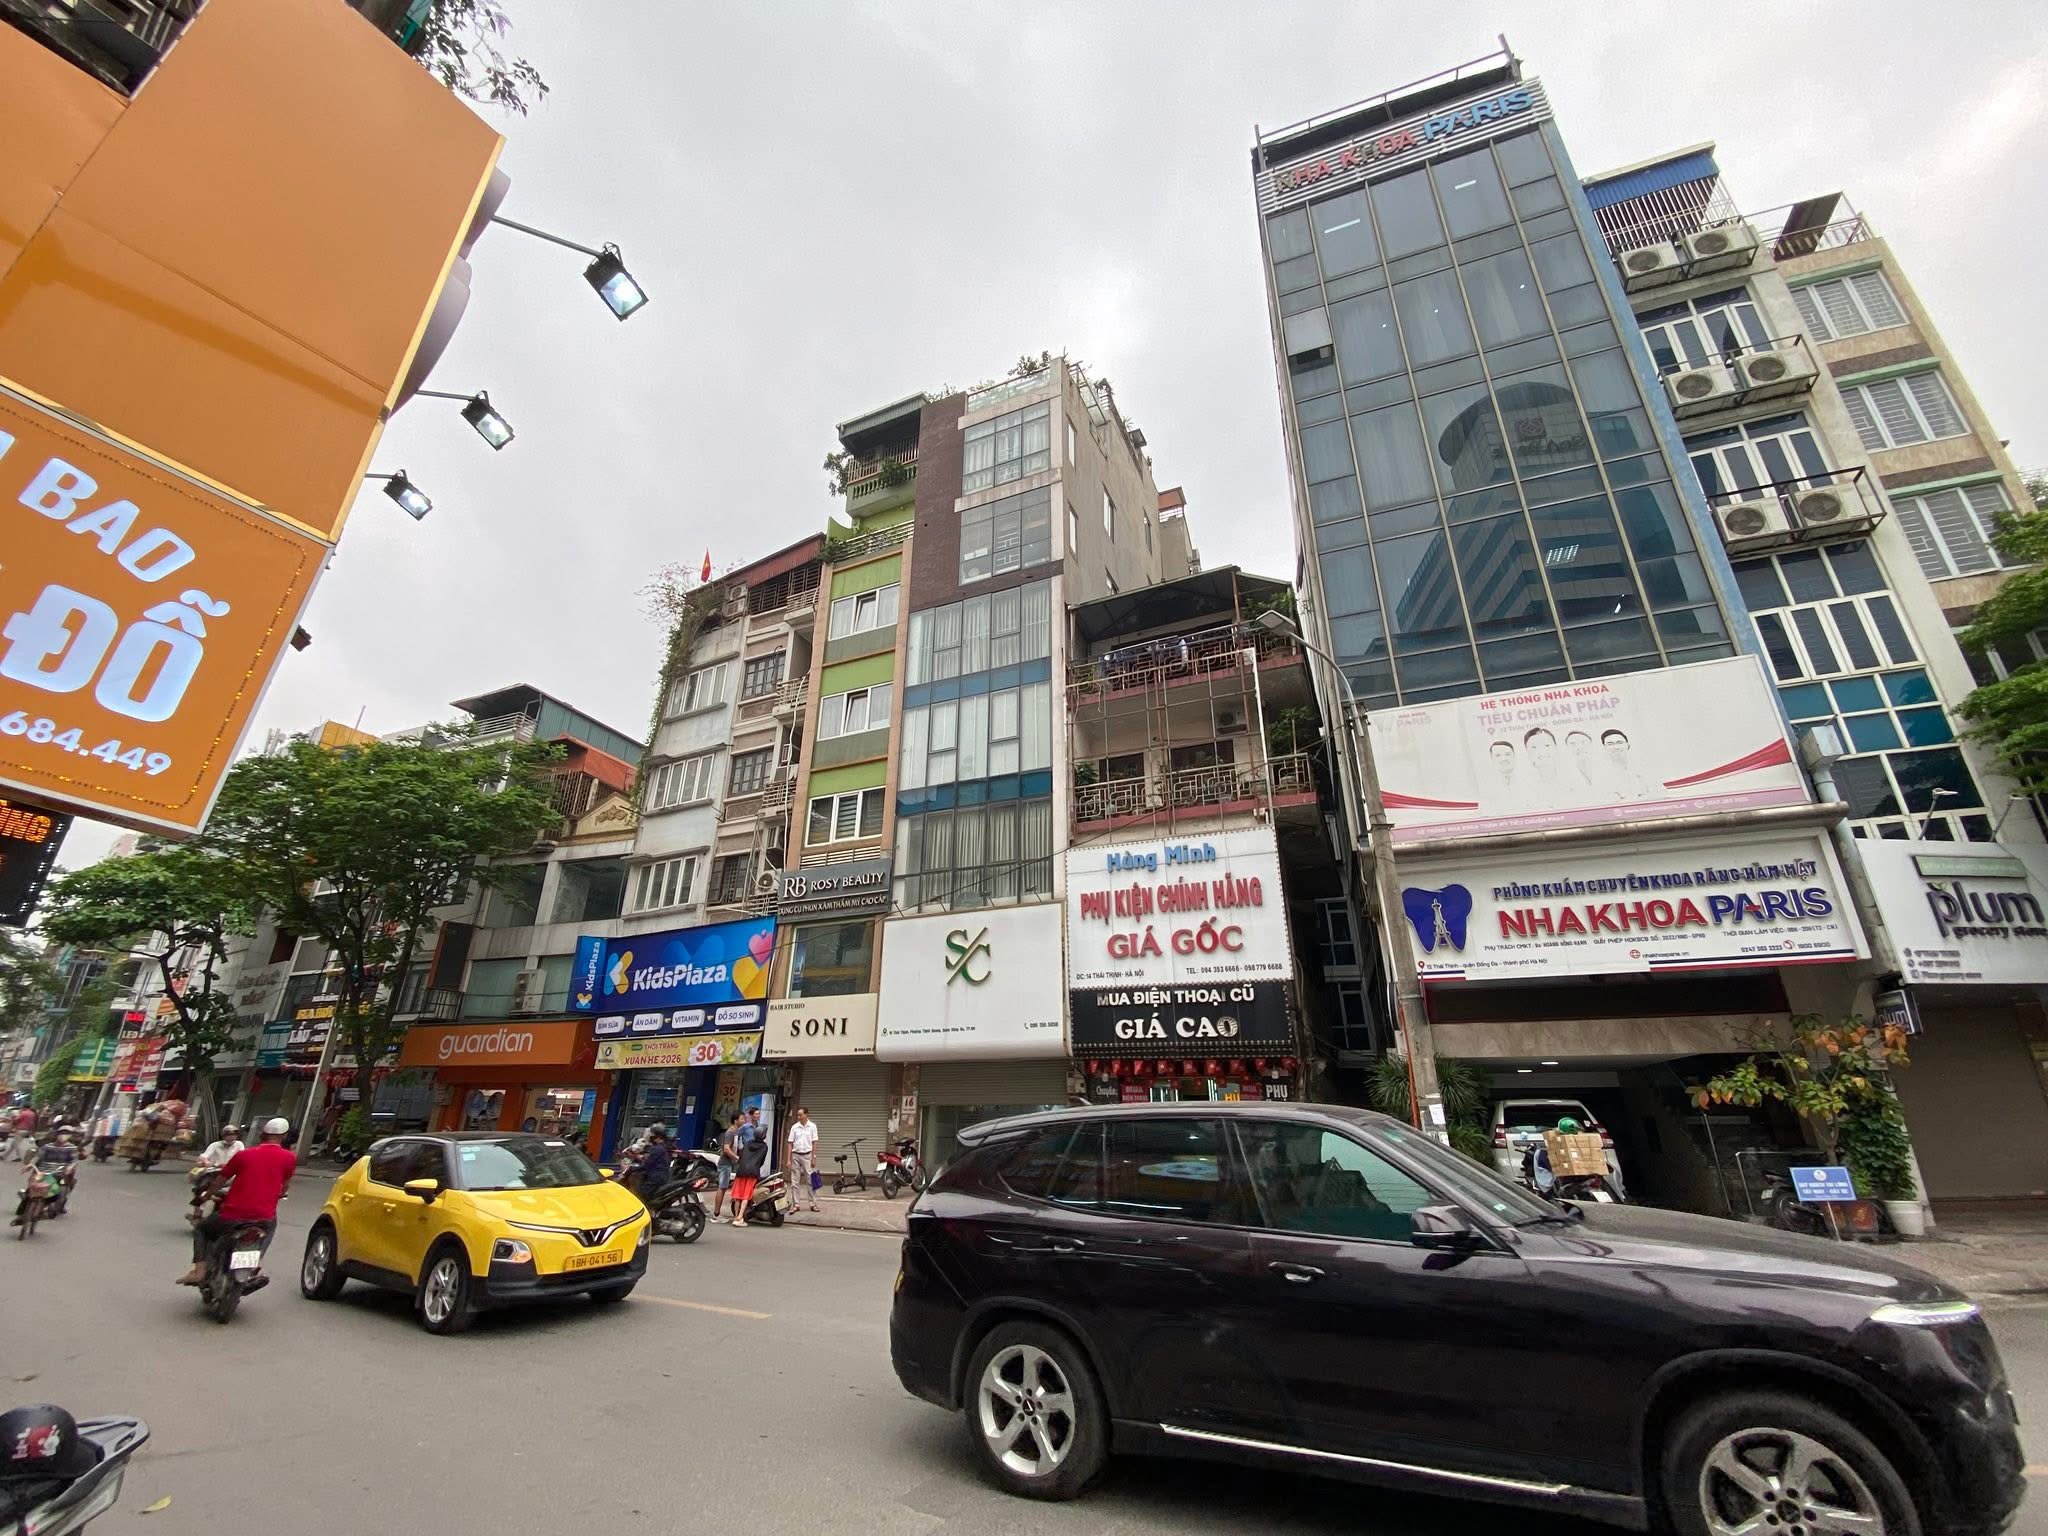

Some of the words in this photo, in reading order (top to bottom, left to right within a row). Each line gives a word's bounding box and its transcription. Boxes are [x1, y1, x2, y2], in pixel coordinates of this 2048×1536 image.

[1273, 160, 1333, 193] NHA
[1423, 88, 1534, 140] PARIS
[18, 457, 196, 583] BAO
[0, 583, 231, 723] ĐỖ
[1544, 690, 1571, 701] NHA
[1573, 684, 1610, 697] KHOA
[1164, 843, 1216, 865] Minh
[783, 876, 807, 897] RB
[811, 878, 840, 891] ROSY
[842, 871, 884, 887] BEAUTY
[1542, 877, 1586, 898] KHÁM
[1114, 882, 1154, 922] KIỆN
[1157, 876, 1208, 913] CHÍNH
[1497, 906, 1586, 937] NHA
[1585, 897, 1709, 934] KHOA
[1706, 887, 1833, 924] PARIS
[1926, 881, 2045, 938] plum
[1107, 925, 1163, 959] GIÁ
[1171, 916, 1244, 955] GỐC
[585, 942, 600, 991] KidsPlaza
[633, 963, 728, 991] KidsPlaza
[770, 1003, 783, 1011] HAIR
[784, 1002, 805, 1010] STUDIO
[1097, 992, 1131, 1007] MUA
[1133, 986, 1171, 1008] ĐIỆN
[1175, 988, 1227, 1006] THOẠI
[1230, 983, 1255, 1002] CŨ
[674, 1014, 700, 1024] VITAMIN
[738, 1011, 754, 1020] SINH
[790, 1017, 848, 1038] SONI
[1115, 1013, 1168, 1039] GIÁ
[1176, 1016, 1239, 1038] CAO
[438, 1028, 533, 1060] guardian
[660, 1054, 682, 1064] 2026
